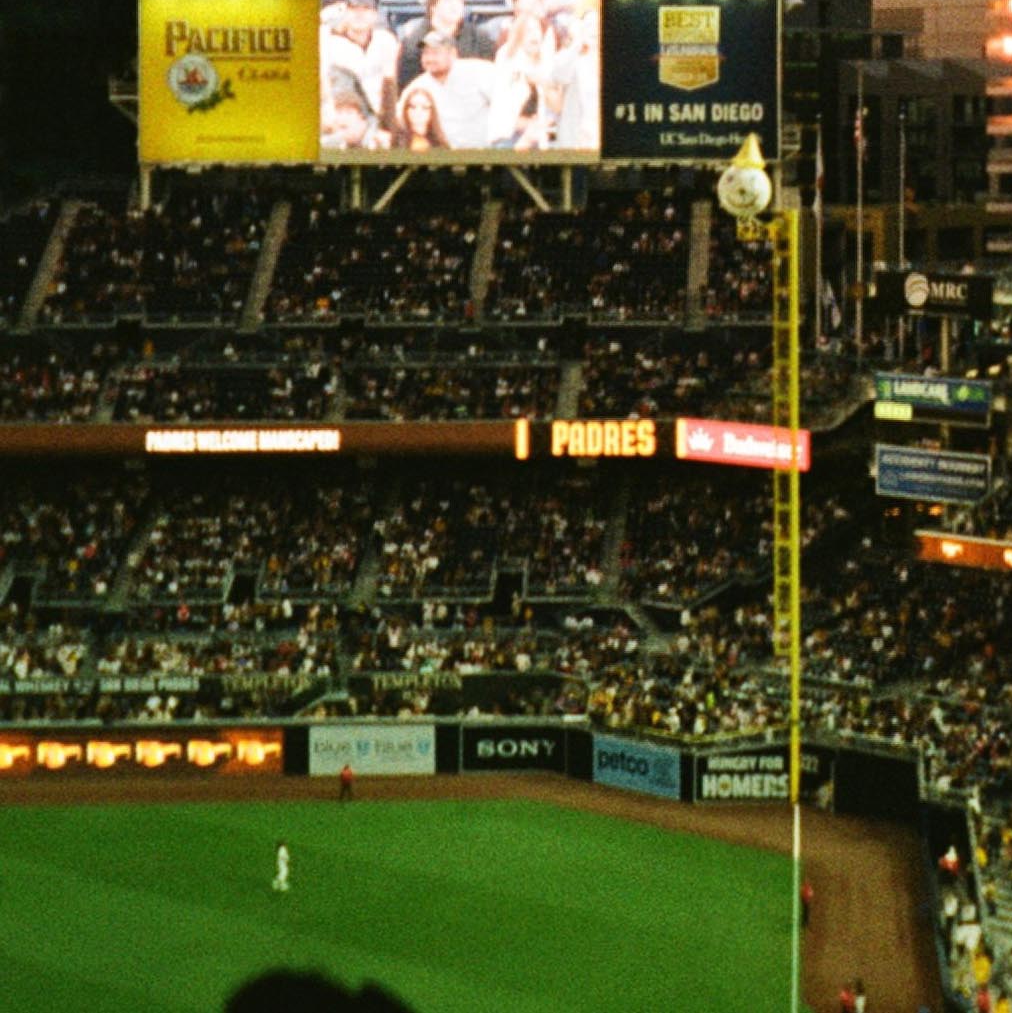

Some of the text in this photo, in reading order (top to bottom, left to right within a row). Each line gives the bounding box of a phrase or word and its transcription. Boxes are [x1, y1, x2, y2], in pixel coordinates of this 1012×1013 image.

[615, 102, 764, 122] #1 IN SAN DIEGO
[929, 282, 968, 300] MRC
[552, 418, 655, 457] PADRES
[477, 739, 556, 758] SONY
[599, 750, 648, 776] petco
[759, 755, 784, 770] FOR
[702, 773, 788, 799] HOMERS
